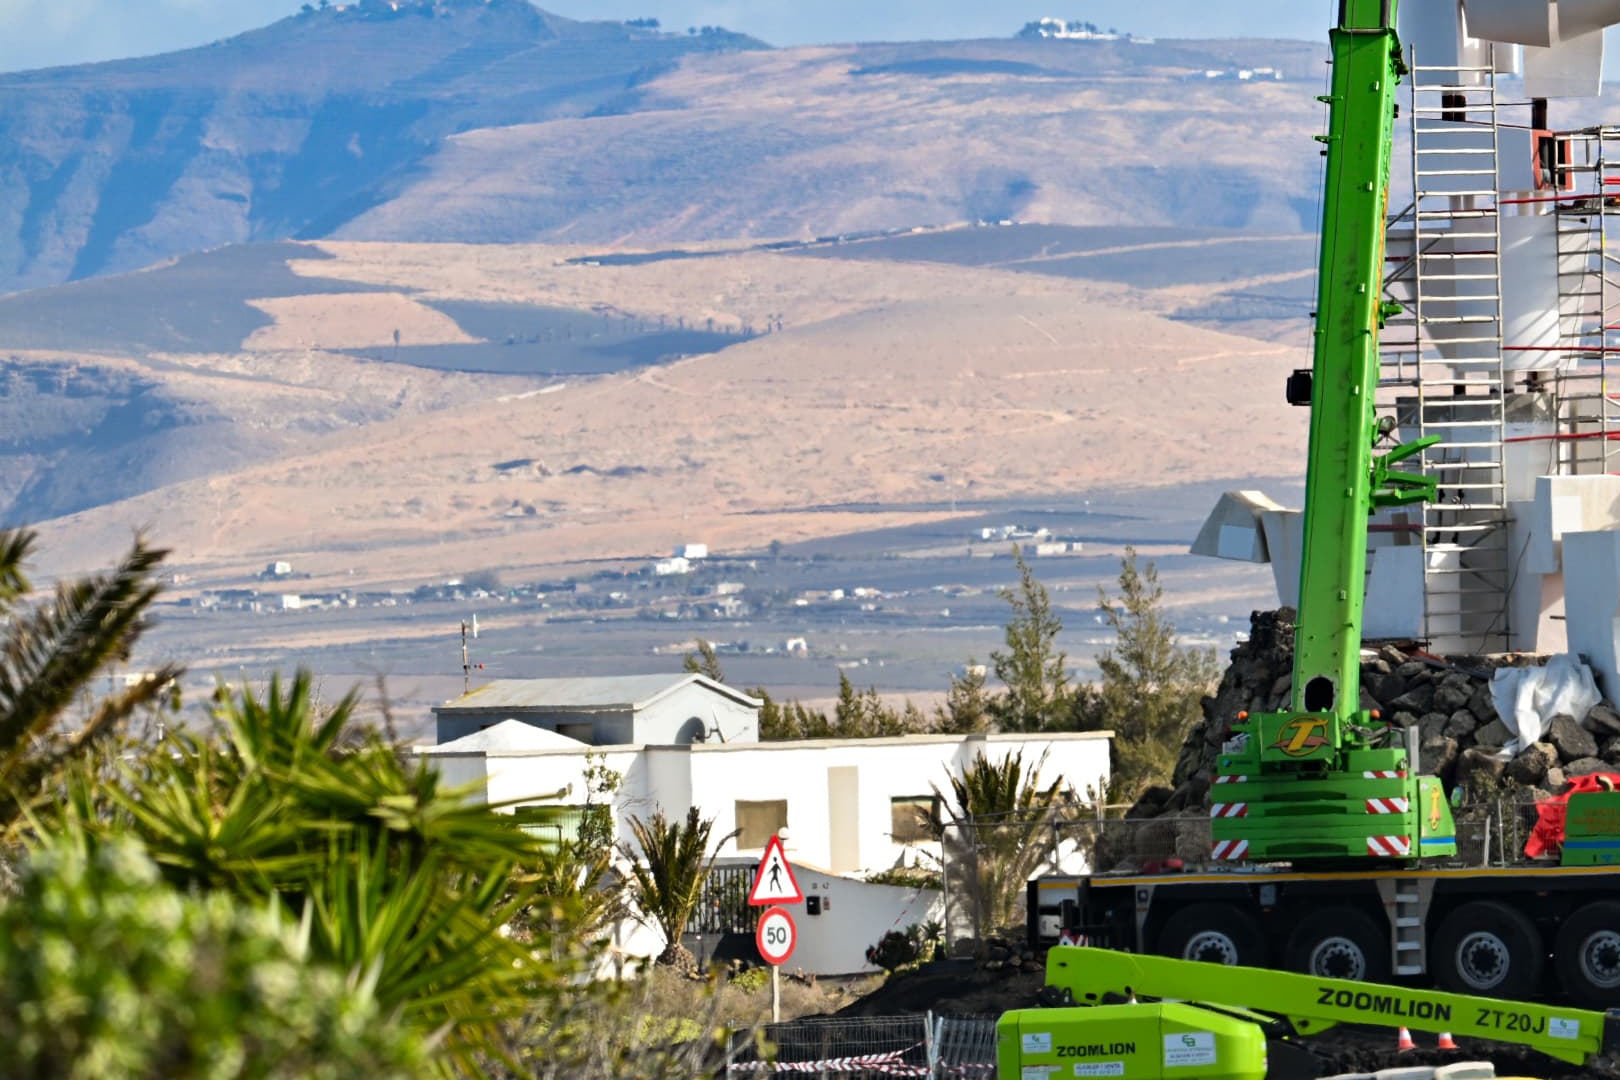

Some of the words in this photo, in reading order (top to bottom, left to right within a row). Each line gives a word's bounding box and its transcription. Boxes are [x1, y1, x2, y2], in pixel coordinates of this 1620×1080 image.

[767, 927, 786, 944] 50
[1317, 987, 1452, 1022] ZOOMLION
[1475, 1008, 1546, 1034] ZT20J
[1056, 1042, 1136, 1057] ZOOMLION
